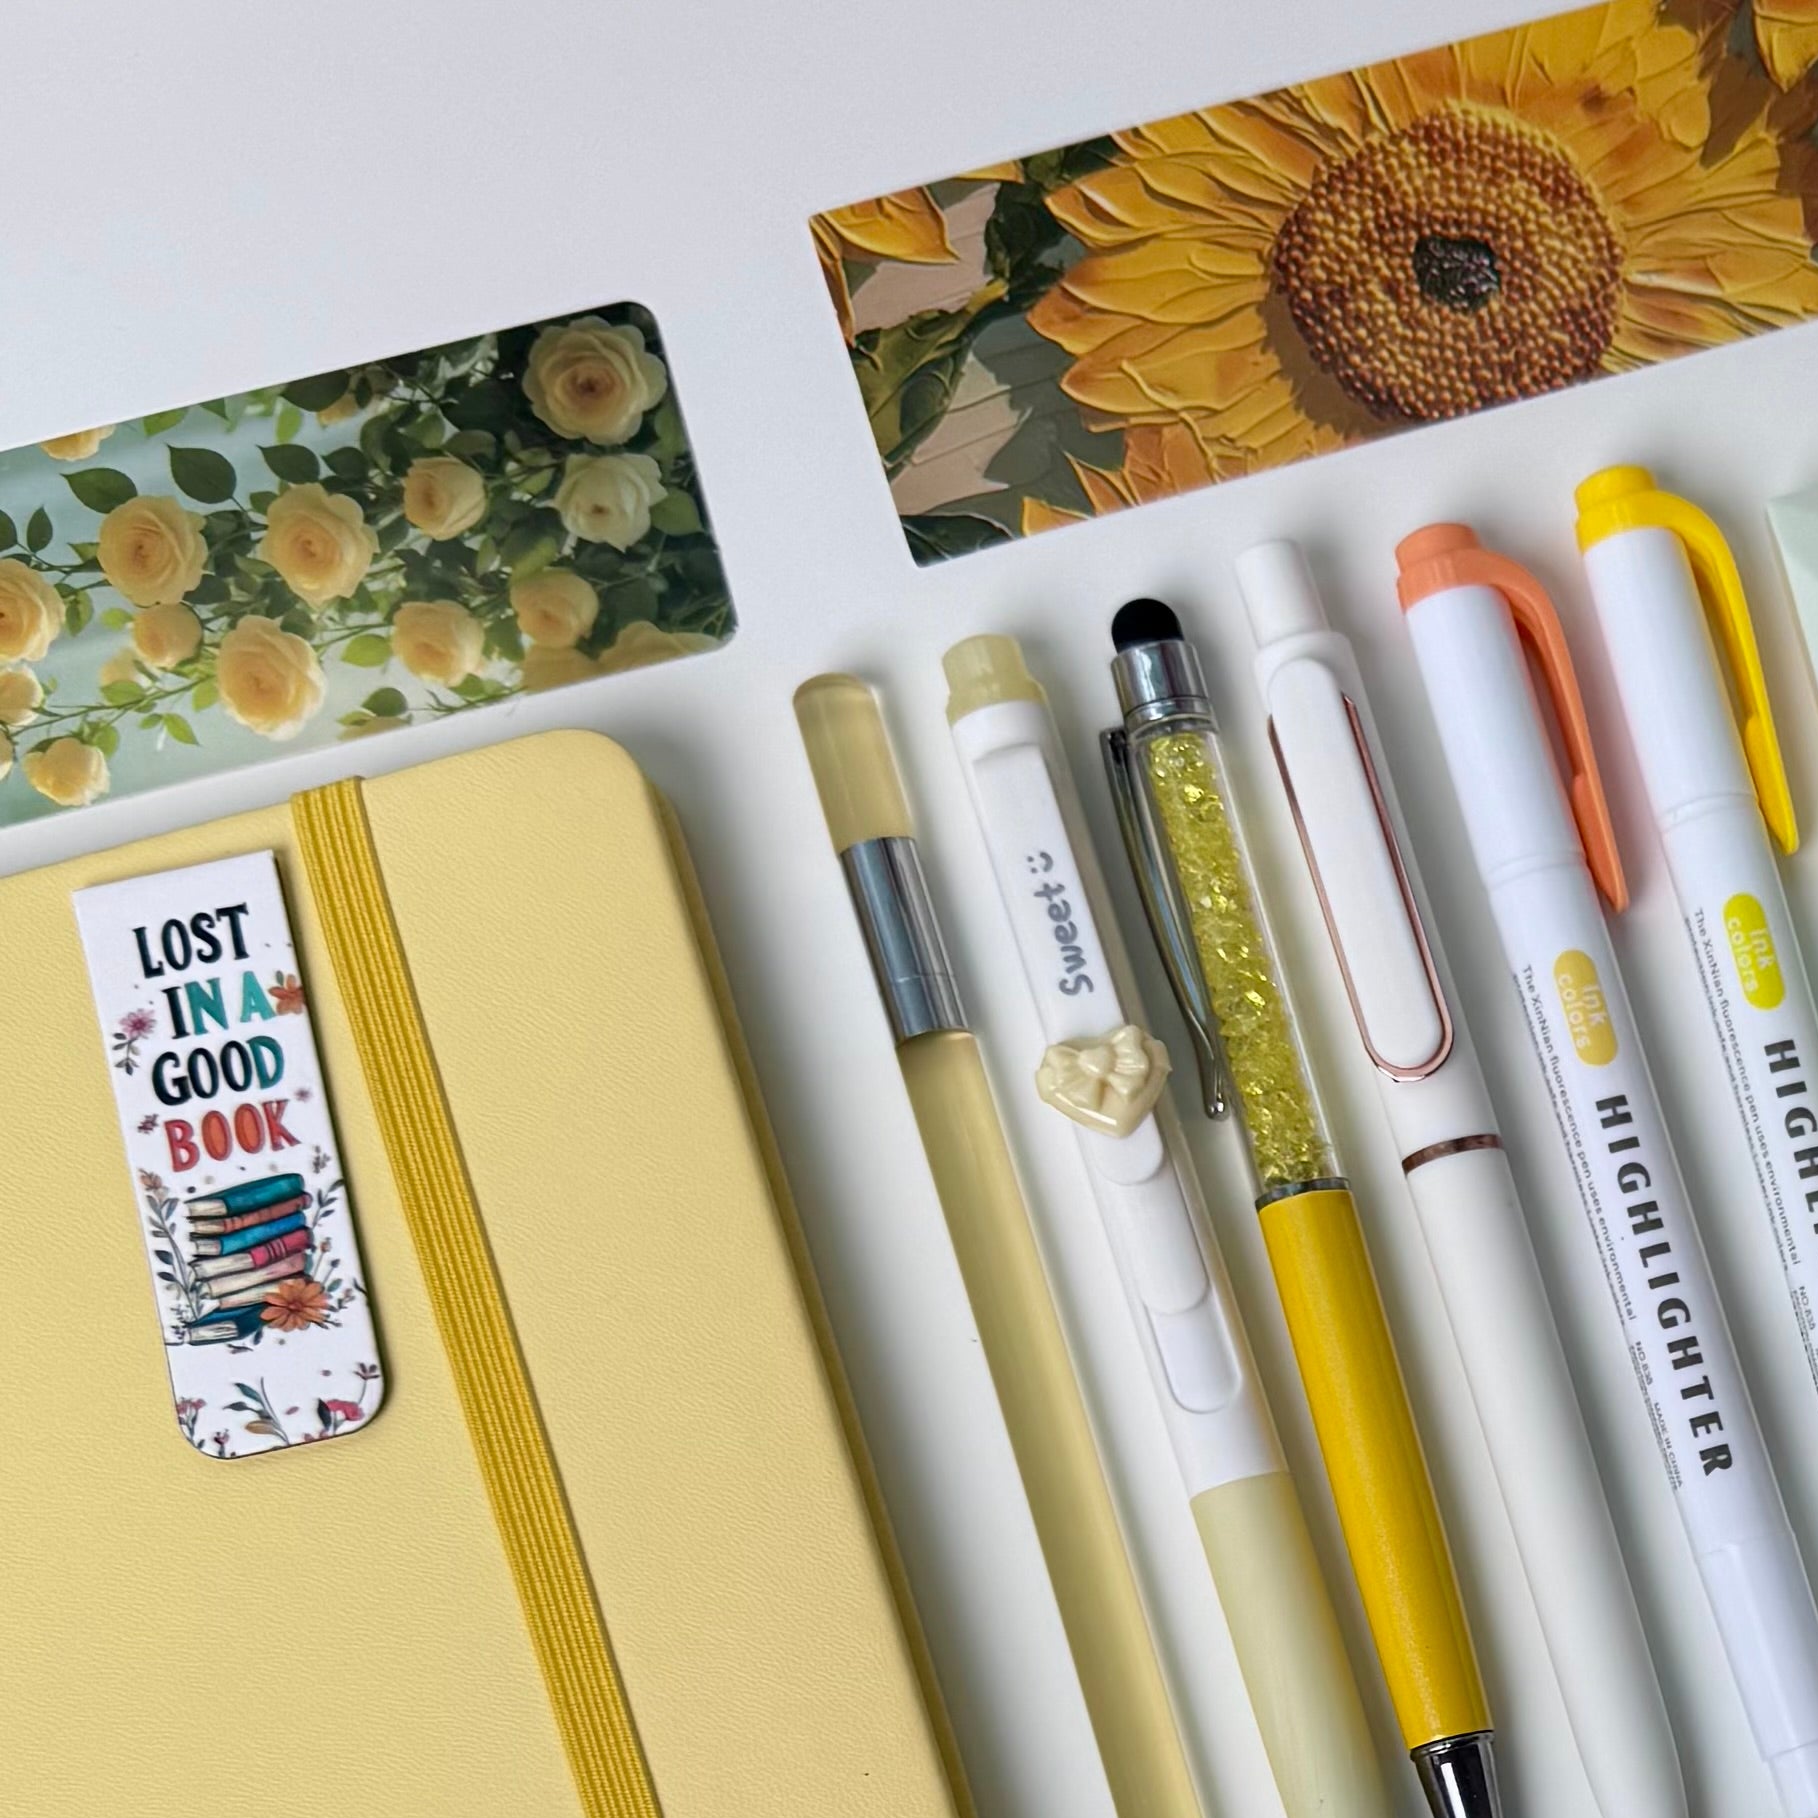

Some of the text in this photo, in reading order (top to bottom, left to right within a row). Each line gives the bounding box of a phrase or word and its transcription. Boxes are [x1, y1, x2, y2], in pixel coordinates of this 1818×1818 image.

[132, 902, 250, 979] LOST
[1033, 882, 1094, 996] Sweet
[1727, 916, 1758, 994] colors
[161, 970, 275, 1040] IN A
[1558, 972, 1591, 1049] colors
[151, 1034, 286, 1106] GOOD
[1692, 907, 1709, 936] The
[1717, 998, 1753, 1092] fluorescence
[1744, 1094, 1761, 1123] pen
[1753, 1124, 1770, 1159] uses
[1763, 1160, 1801, 1265] environmental
[163, 1098, 301, 1173] BOOK
[1521, 964, 1538, 993] The
[1548, 1054, 1585, 1148] fluorescence
[1576, 1150, 1594, 1179] pen
[1586, 1180, 1604, 1214] uses
[1597, 1216, 1637, 1321] environmental
[1595, 1094, 1733, 1476] HIGHLIGHTER
